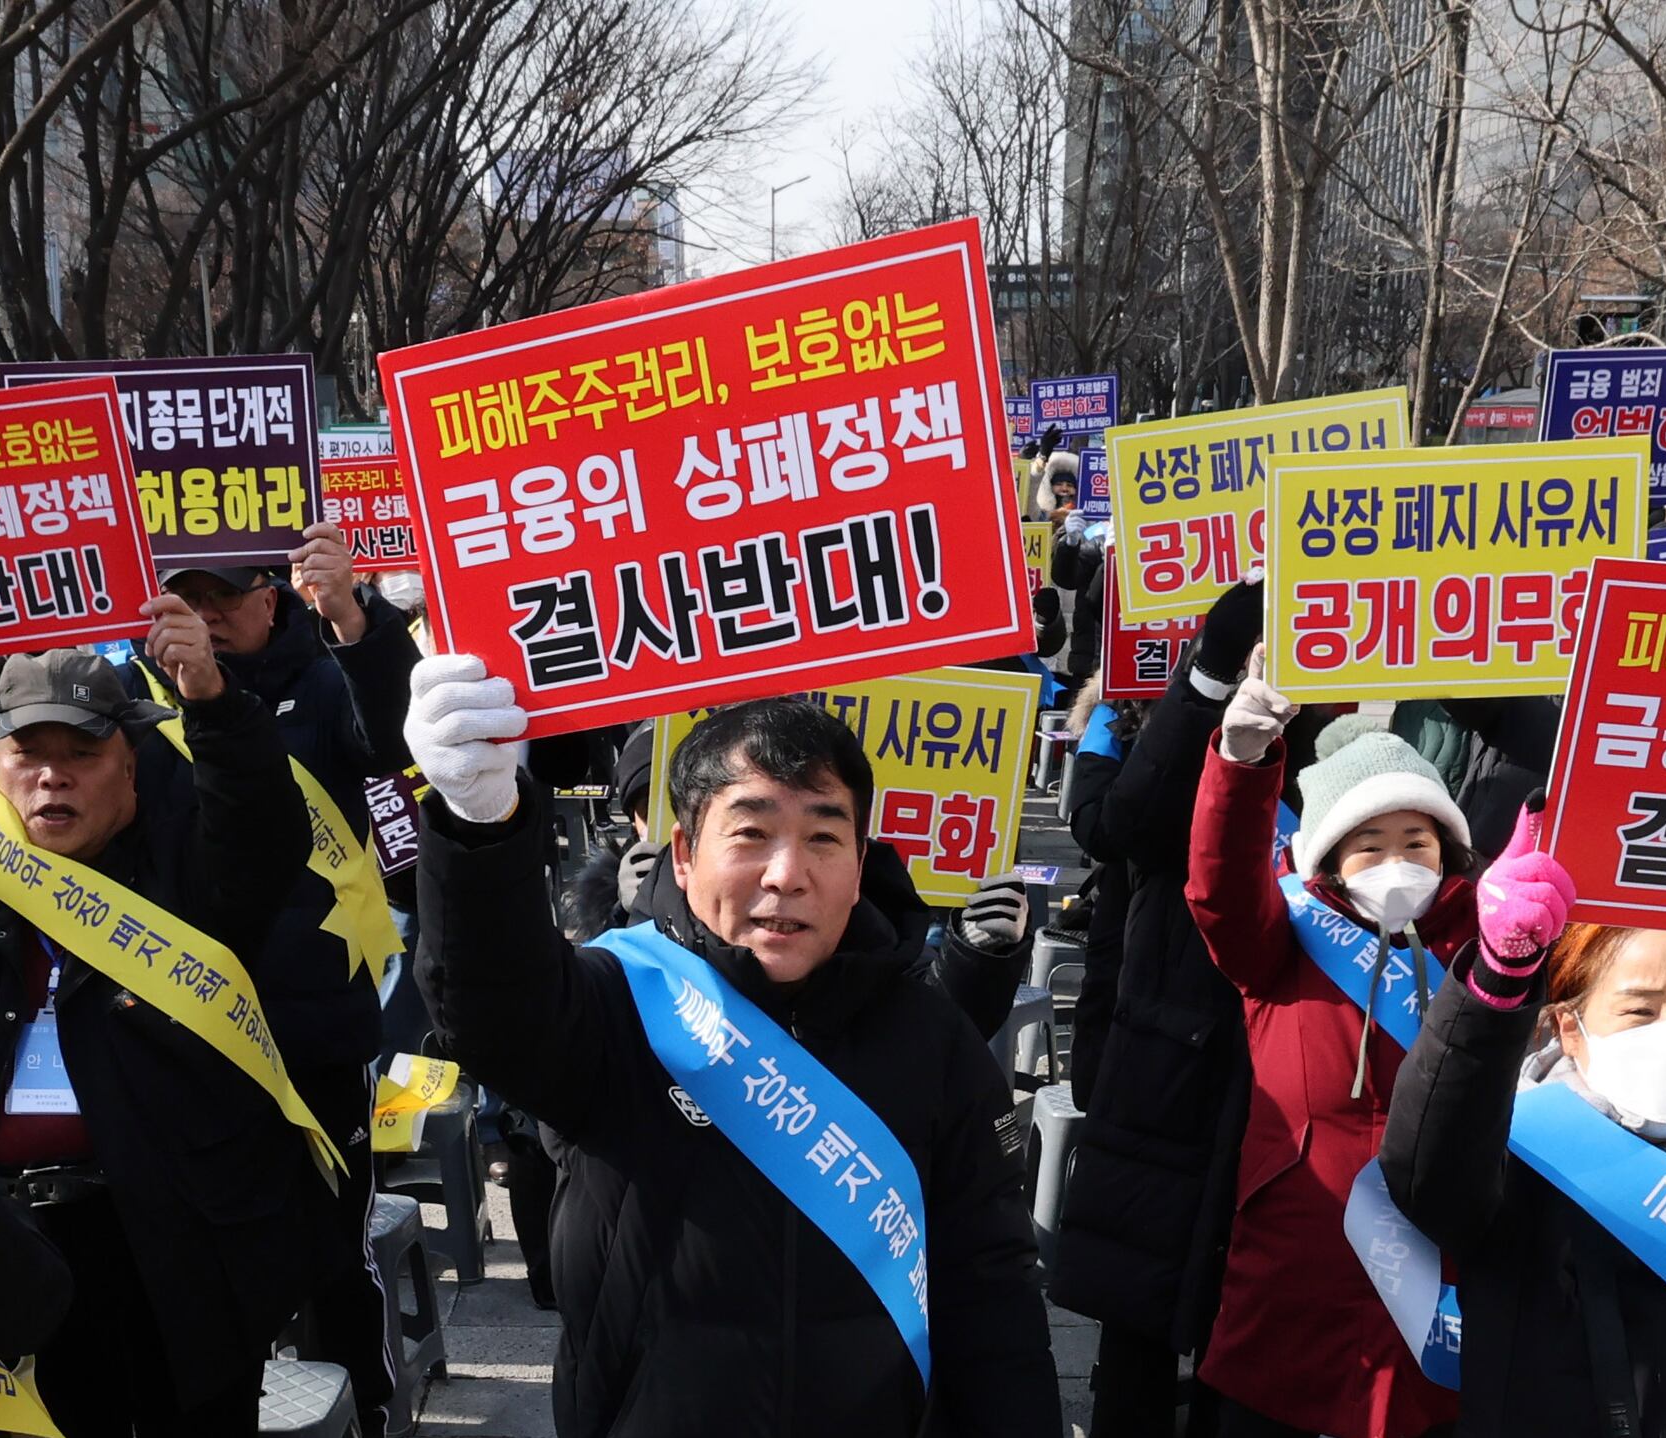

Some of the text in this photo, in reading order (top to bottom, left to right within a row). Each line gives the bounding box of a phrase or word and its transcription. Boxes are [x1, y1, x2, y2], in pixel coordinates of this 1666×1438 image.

[430, 291, 947, 459] 피해주주권리, 보호없는
[1041, 395, 1107, 418] 엄벌하고
[1569, 369, 1612, 399] 금융
[1620, 367, 1663, 398] 범죄
[148, 388, 204, 450] 종목
[209, 384, 295, 448] 단계적
[137, 466, 306, 536] 허용하라
[444, 380, 968, 569] 금융위 상폐정책
[1134, 444, 1200, 506] 상장
[1138, 511, 1239, 595] 공개
[1297, 485, 1383, 559] 상장
[1391, 483, 1476, 553] 폐지
[1489, 476, 1618, 549] 사유서
[508, 503, 950, 693] 결사반대!
[1291, 578, 1420, 671] 공개
[876, 698, 1008, 774] 사유서
[52, 875, 112, 928] 상장
[109, 914, 173, 968] 폐지
[168, 951, 231, 1004] 정책
[673, 974, 920, 1260] 금융위 상장 폐지 정책
